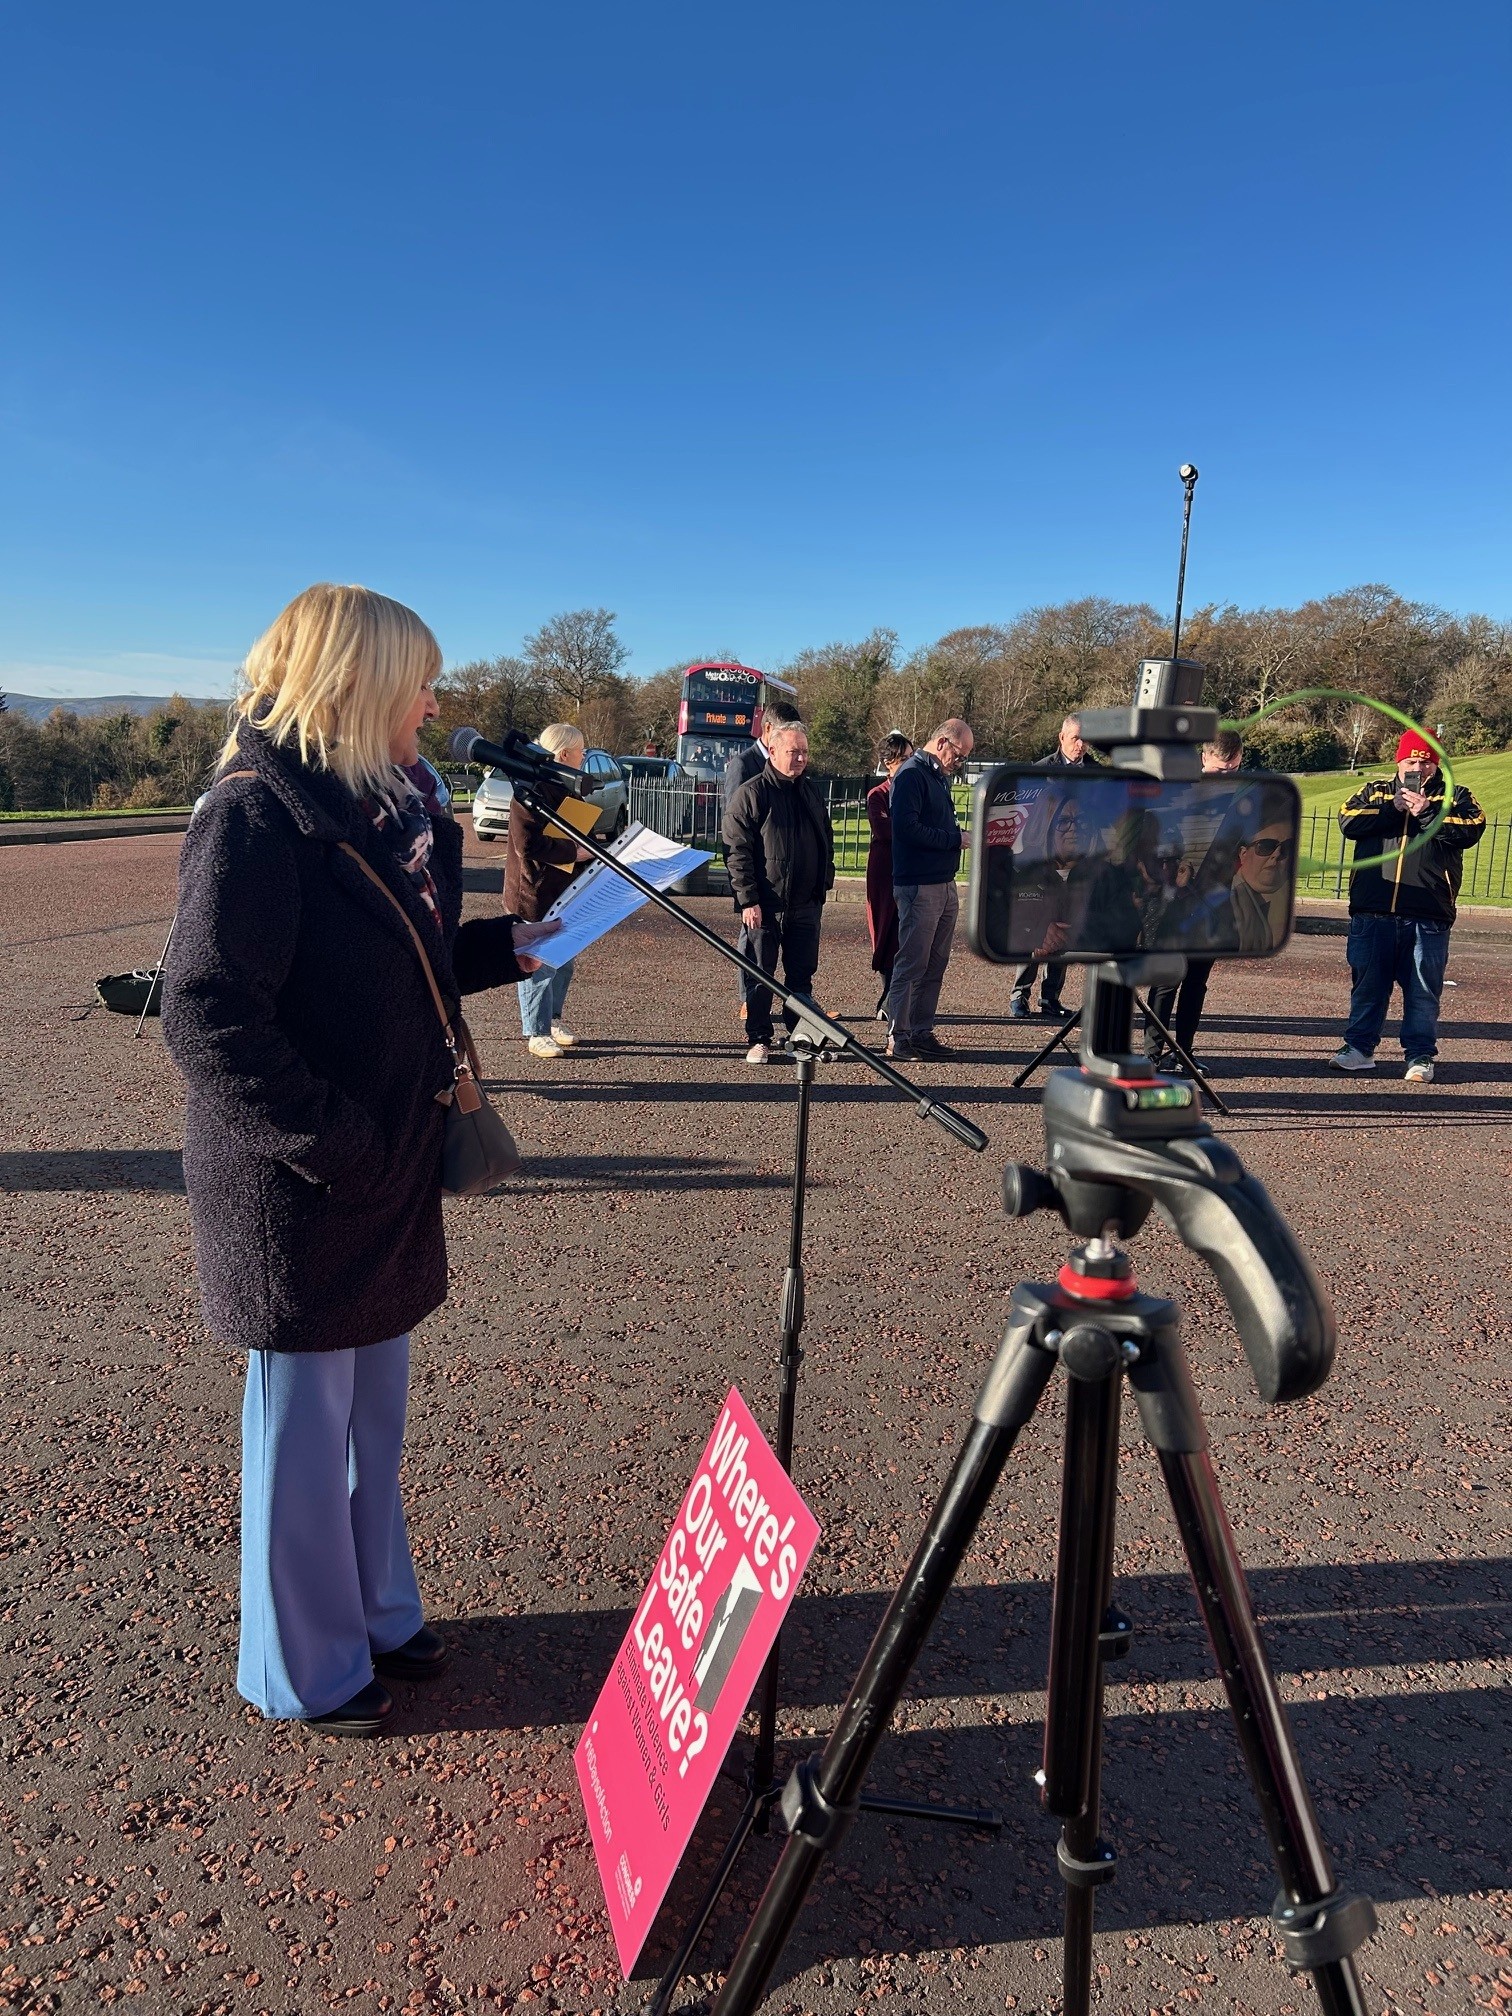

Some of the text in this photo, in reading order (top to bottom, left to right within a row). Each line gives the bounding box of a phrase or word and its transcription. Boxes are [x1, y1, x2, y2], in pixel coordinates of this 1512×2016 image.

[706, 713, 746, 725] Private 888
[1411, 749, 1431, 759] pcs
[685, 1473, 727, 1574] Our
[708, 1407, 798, 1602] Where's
[660, 1528, 704, 1650] Safe
[625, 1639, 669, 1776] Eliminate Violence
[634, 1582, 708, 1779] Leave?
[584, 1736, 613, 1843] #16DaysofAction
[617, 1661, 671, 1832] against Women & Girls
